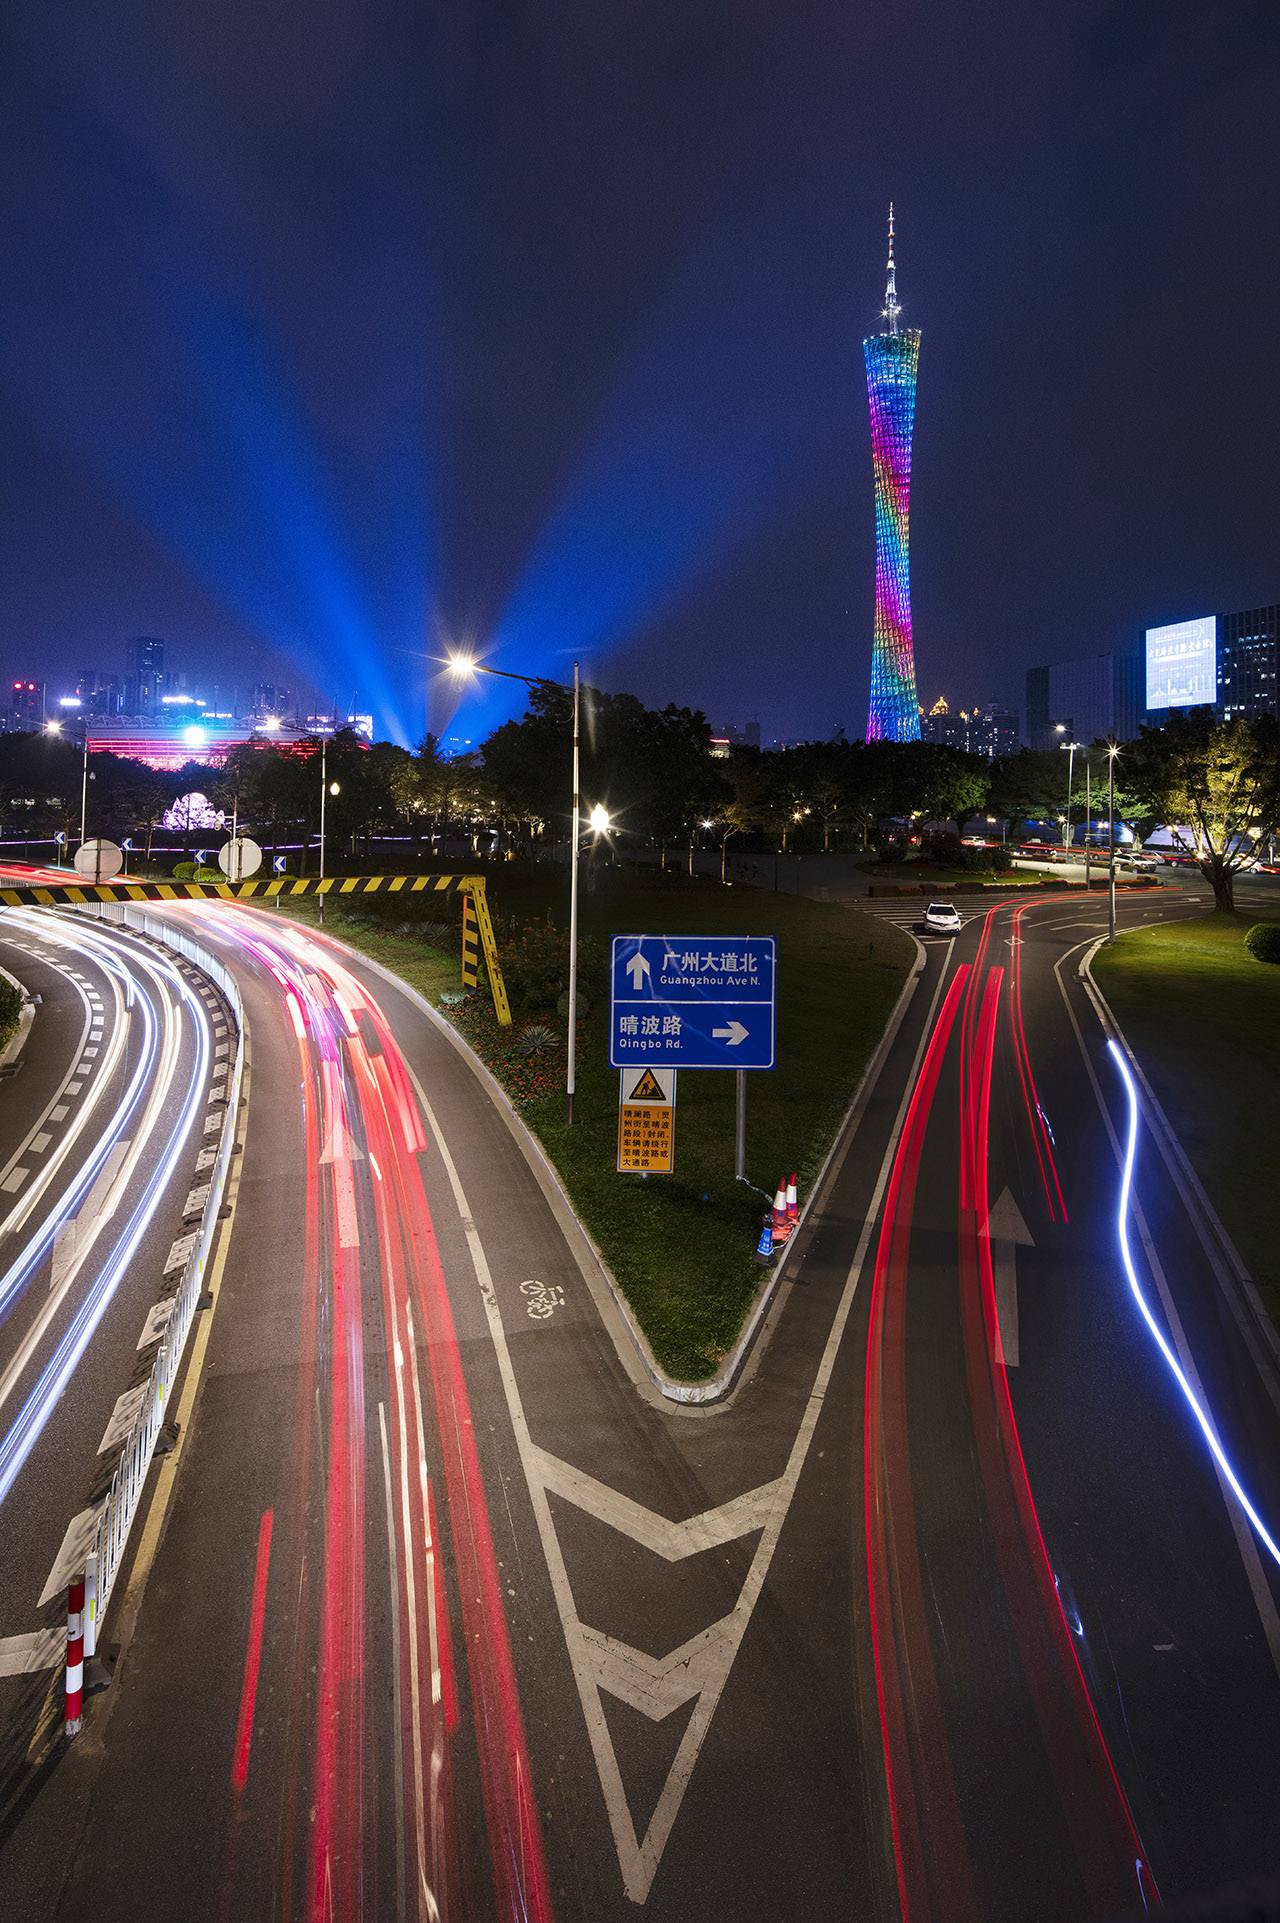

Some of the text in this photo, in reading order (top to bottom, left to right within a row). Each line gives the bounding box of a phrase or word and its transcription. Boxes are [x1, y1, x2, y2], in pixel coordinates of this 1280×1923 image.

[661, 951, 758, 972] 广州大道北
[660, 975, 761, 987] Guangzhou Ave N.
[619, 1015, 682, 1036] 晴波路
[619, 1038, 683, 1050] Qingbo Rd.
[623, 1139, 669, 1148] 车辆请绕行
